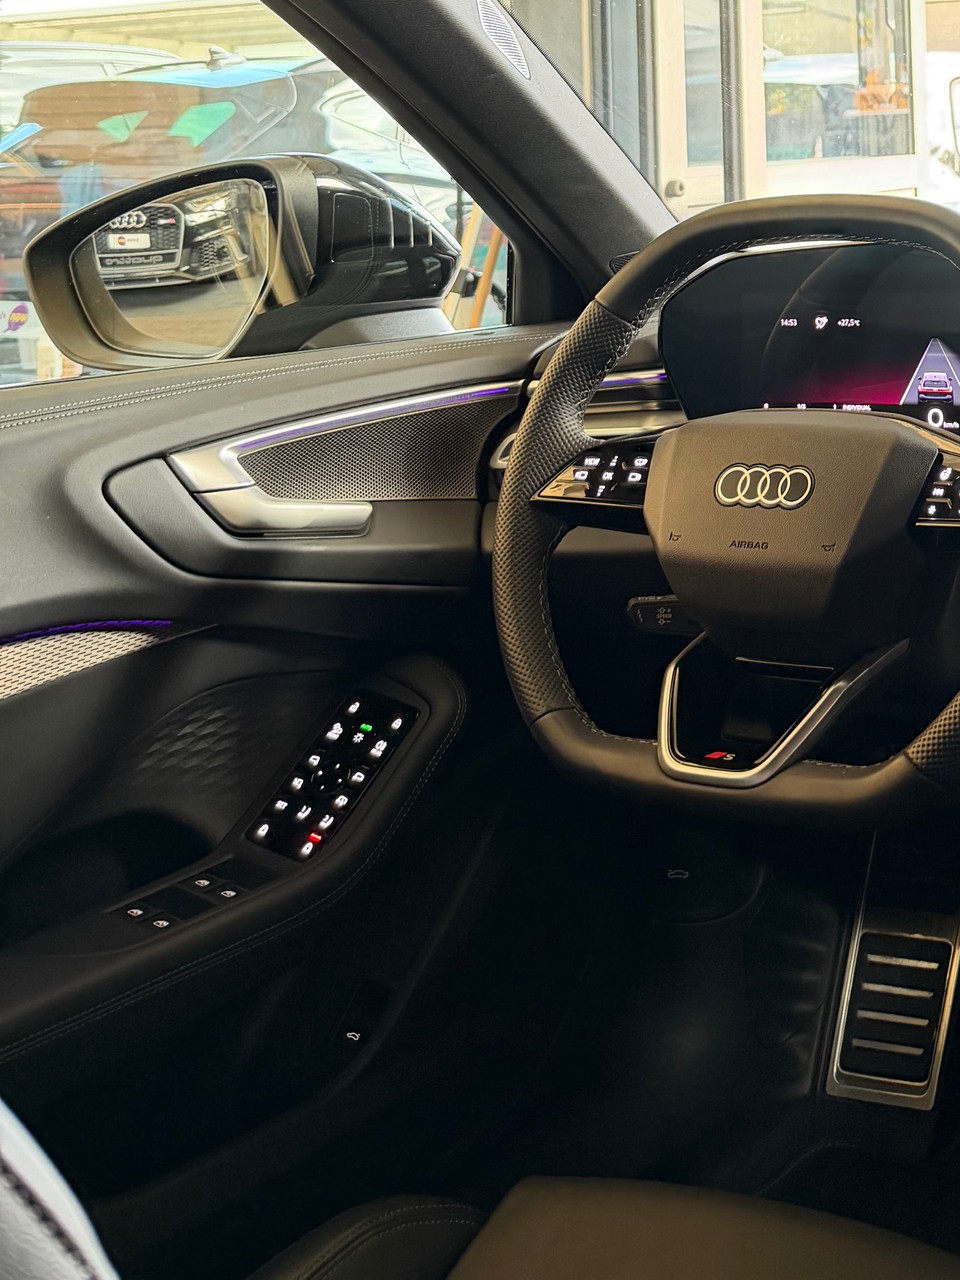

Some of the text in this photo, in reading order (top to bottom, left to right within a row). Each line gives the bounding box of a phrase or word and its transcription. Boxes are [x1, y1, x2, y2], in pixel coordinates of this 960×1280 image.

[780, 318, 798, 327] 14:53
[927, 408, 960, 429] 0 km/h
[584, 457, 600, 467] VIEW
[602, 471, 614, 481] OK
[729, 540, 769, 550] AIRBAG
